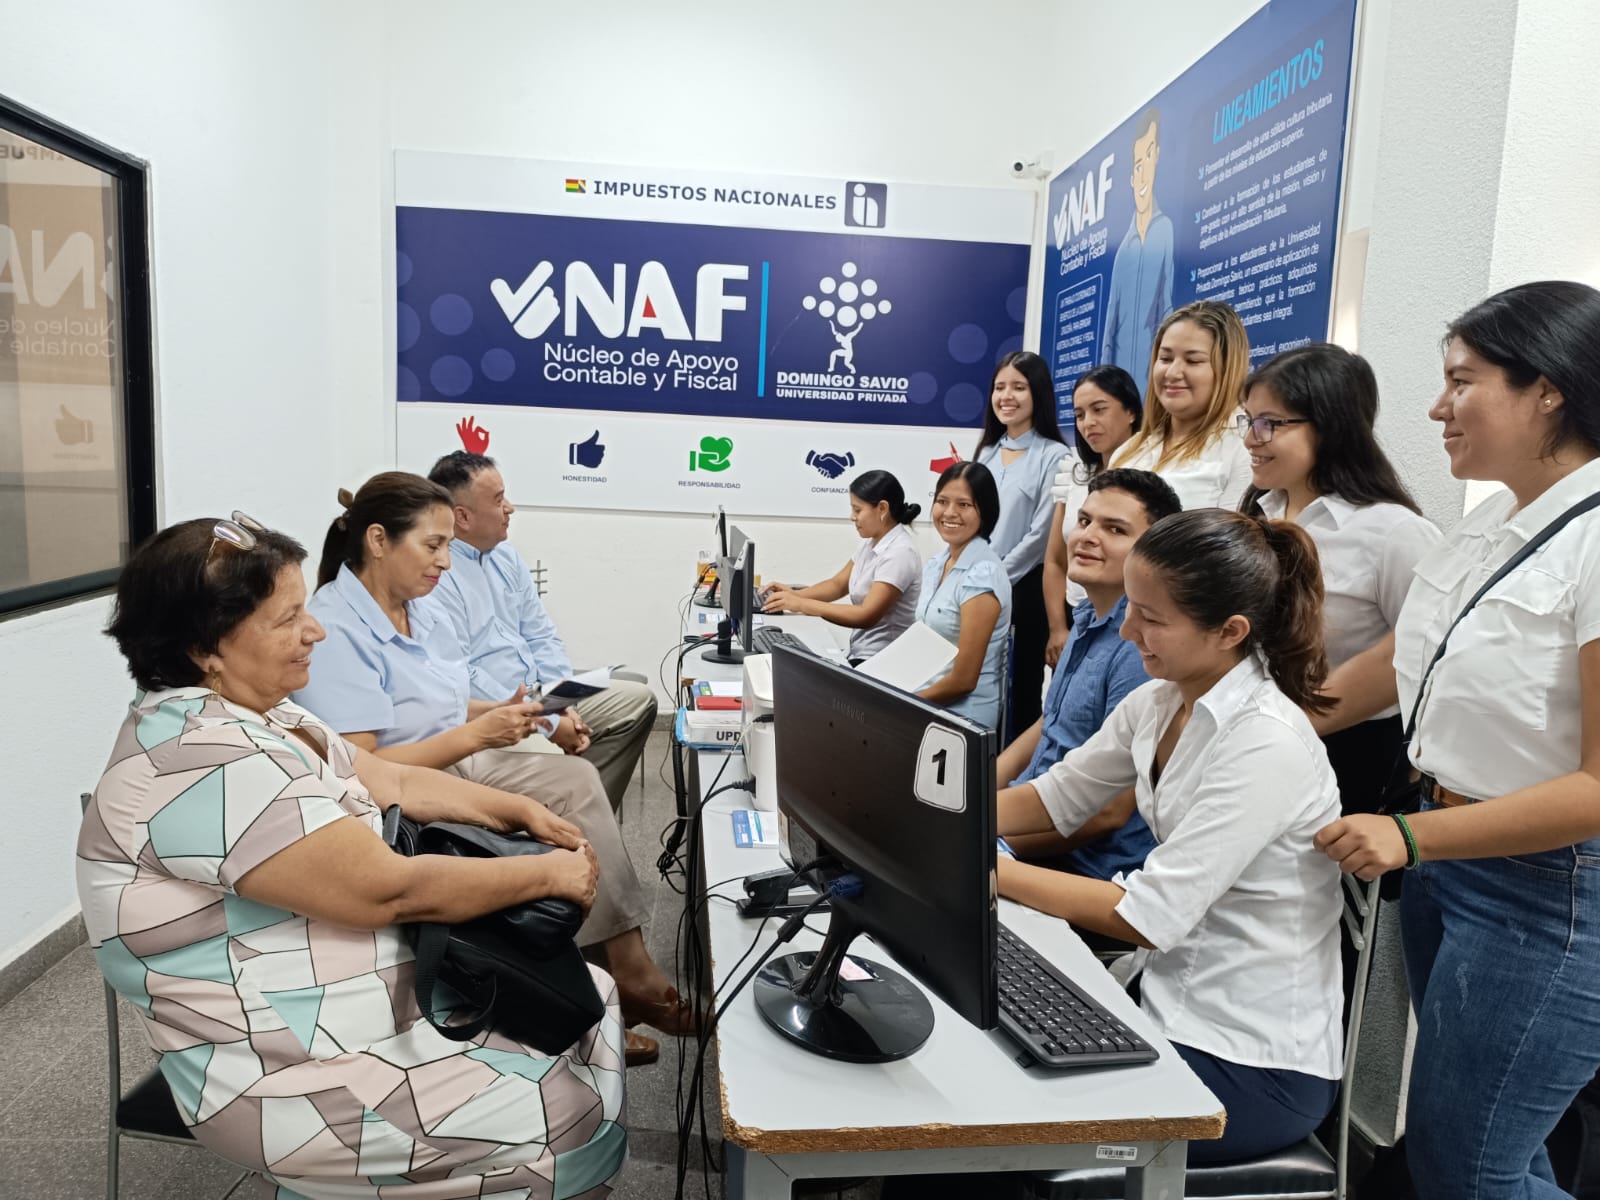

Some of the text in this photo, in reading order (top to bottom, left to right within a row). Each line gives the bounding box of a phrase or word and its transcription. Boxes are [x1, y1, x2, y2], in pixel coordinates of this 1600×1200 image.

[1213, 38, 1324, 144] LINEAMIENTOS
[1287, 109, 1305, 128] cultura
[1306, 93, 1332, 116] tributaria
[1262, 177, 1270, 190] de
[1272, 173, 1281, 185] los
[1283, 155, 1315, 180] estudiantes
[1319, 148, 1327, 162] de
[1303, 170, 1320, 187] visión
[1321, 168, 1326, 182] y
[593, 180, 837, 210] IMPUESTOS NACIONALES
[1066, 153, 1115, 242] NAF
[1080, 237, 1088, 252] de
[1088, 227, 1108, 249] Apoyo
[1088, 240, 1107, 261] Fiscal
[1230, 256, 1238, 267] los
[1240, 245, 1267, 263] estudiantes
[1269, 239, 1277, 253] de
[1279, 236, 1285, 249] la
[1287, 221, 1321, 246] Universidad
[1275, 255, 1282, 268] de
[1282, 245, 1310, 267] aplicación
[1311, 242, 1319, 256] de
[1287, 262, 1317, 281] adquiridos
[564, 260, 749, 342] NAF
[1265, 293, 1275, 306] que
[1279, 288, 1284, 300] la
[1287, 280, 1316, 298] formación
[1262, 309, 1272, 322] sea
[1272, 303, 1293, 321] integral.
[543, 342, 739, 374] Núcleo de Apoyo
[543, 363, 737, 391] Contable y Fiscal
[777, 371, 909, 390] DOMINGO SAVIO
[776, 388, 907, 403] UNIVERSIDAD PRIVADA
[562, 475, 607, 483] HONESTIDAD
[678, 480, 741, 489] RESPONSABILIDAD
[811, 486, 849, 494] CONFIANZA
[716, 731, 742, 742] UPD
[932, 748, 947, 786] 1
